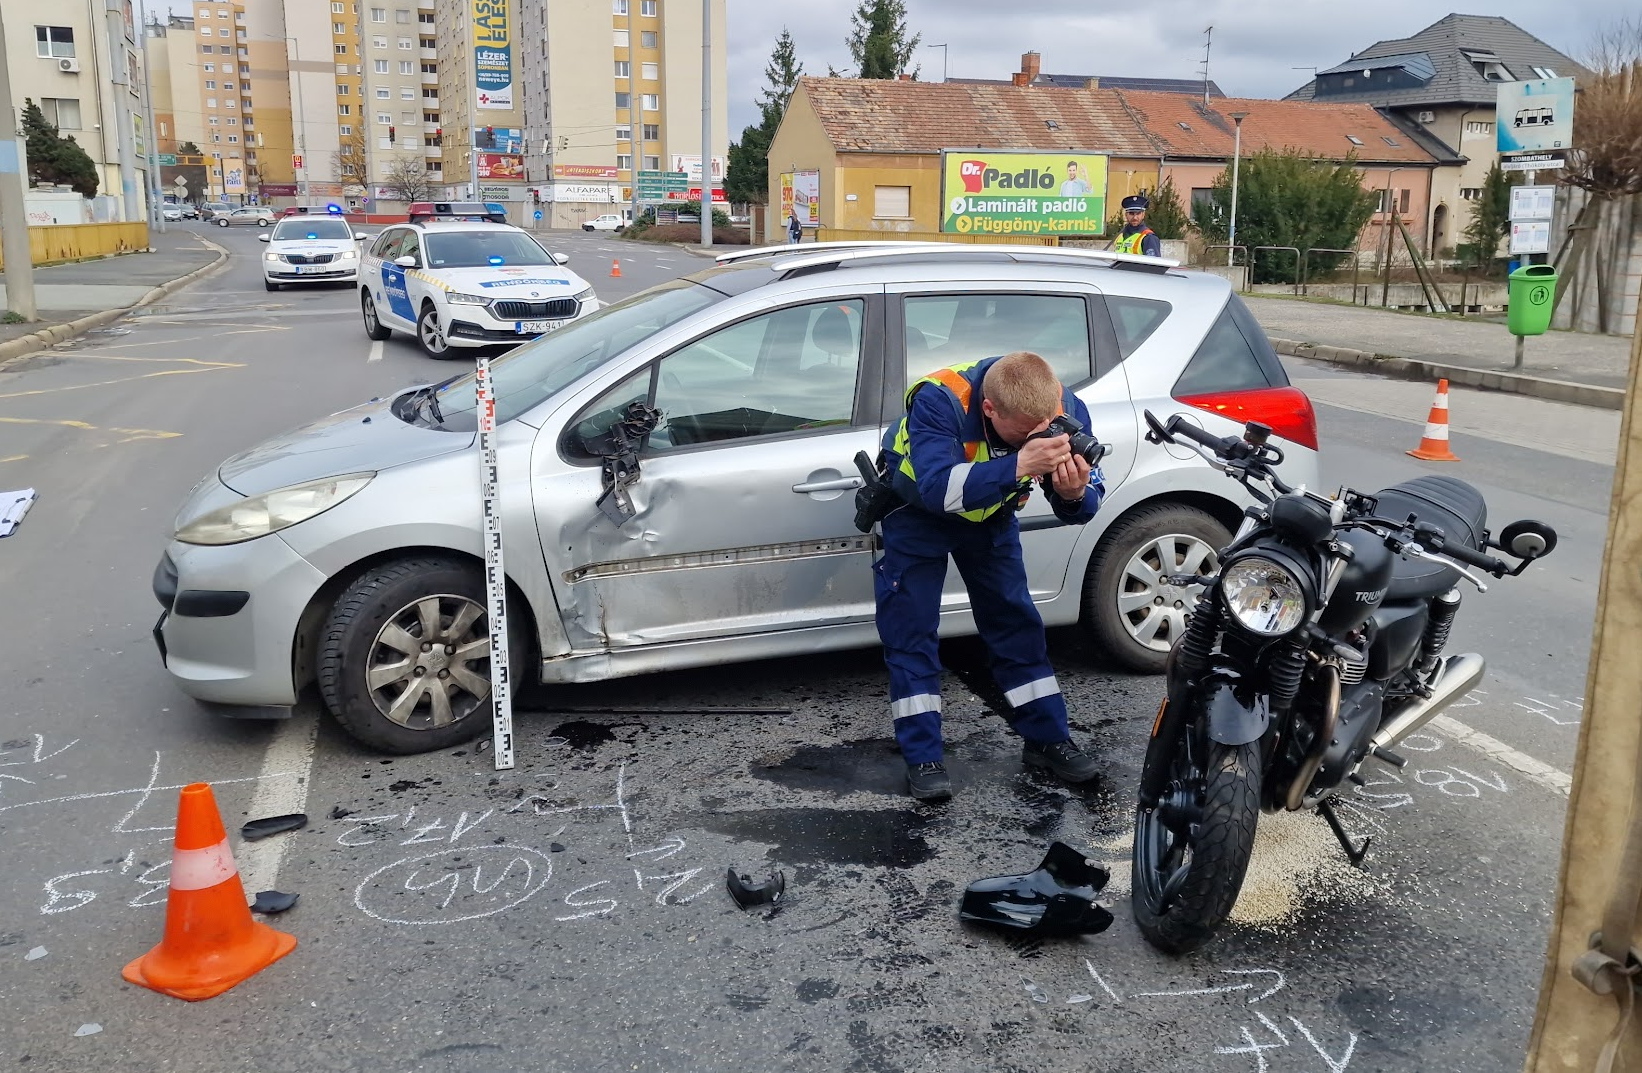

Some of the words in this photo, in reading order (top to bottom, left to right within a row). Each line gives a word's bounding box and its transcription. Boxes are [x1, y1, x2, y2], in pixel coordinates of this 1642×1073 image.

[477, 51, 509, 61] LÉZER-
[1511, 154, 1553, 162] SZOMBATHELY
[962, 162, 981, 175] Dr.
[983, 166, 1055, 189] Padló
[969, 197, 1037, 213] Laminált
[1042, 198, 1088, 215] padló
[973, 216, 1097, 233] Függöny-karnis
